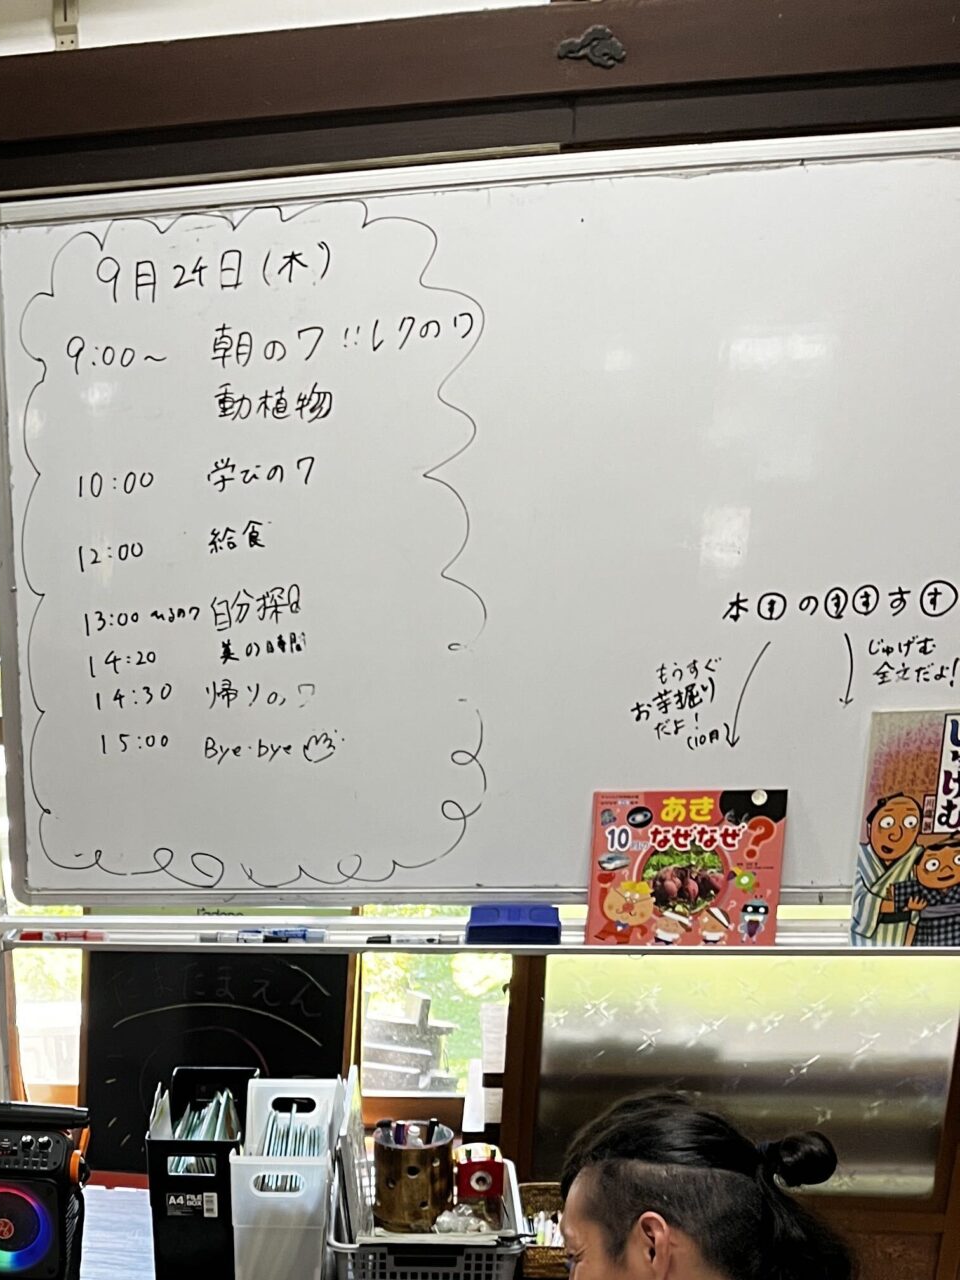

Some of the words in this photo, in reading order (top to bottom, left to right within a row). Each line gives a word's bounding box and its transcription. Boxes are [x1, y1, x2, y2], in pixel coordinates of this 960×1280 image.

[214, 382, 332, 421] 動植物
[78, 472, 154, 497] 10:00
[78, 542, 143, 571] 12:00
[208, 520, 267, 553] 給食
[85, 611, 139, 636] 13:00
[868, 635, 937, 657] じゅげむ
[89, 651, 156, 678] 14:20
[656, 657, 722, 684] もうすぐ
[96, 683, 172, 710] 14:30
[101, 734, 169, 754] 15:00
[661, 797, 714, 822] あき
[169, 1196, 184, 1204] A4
